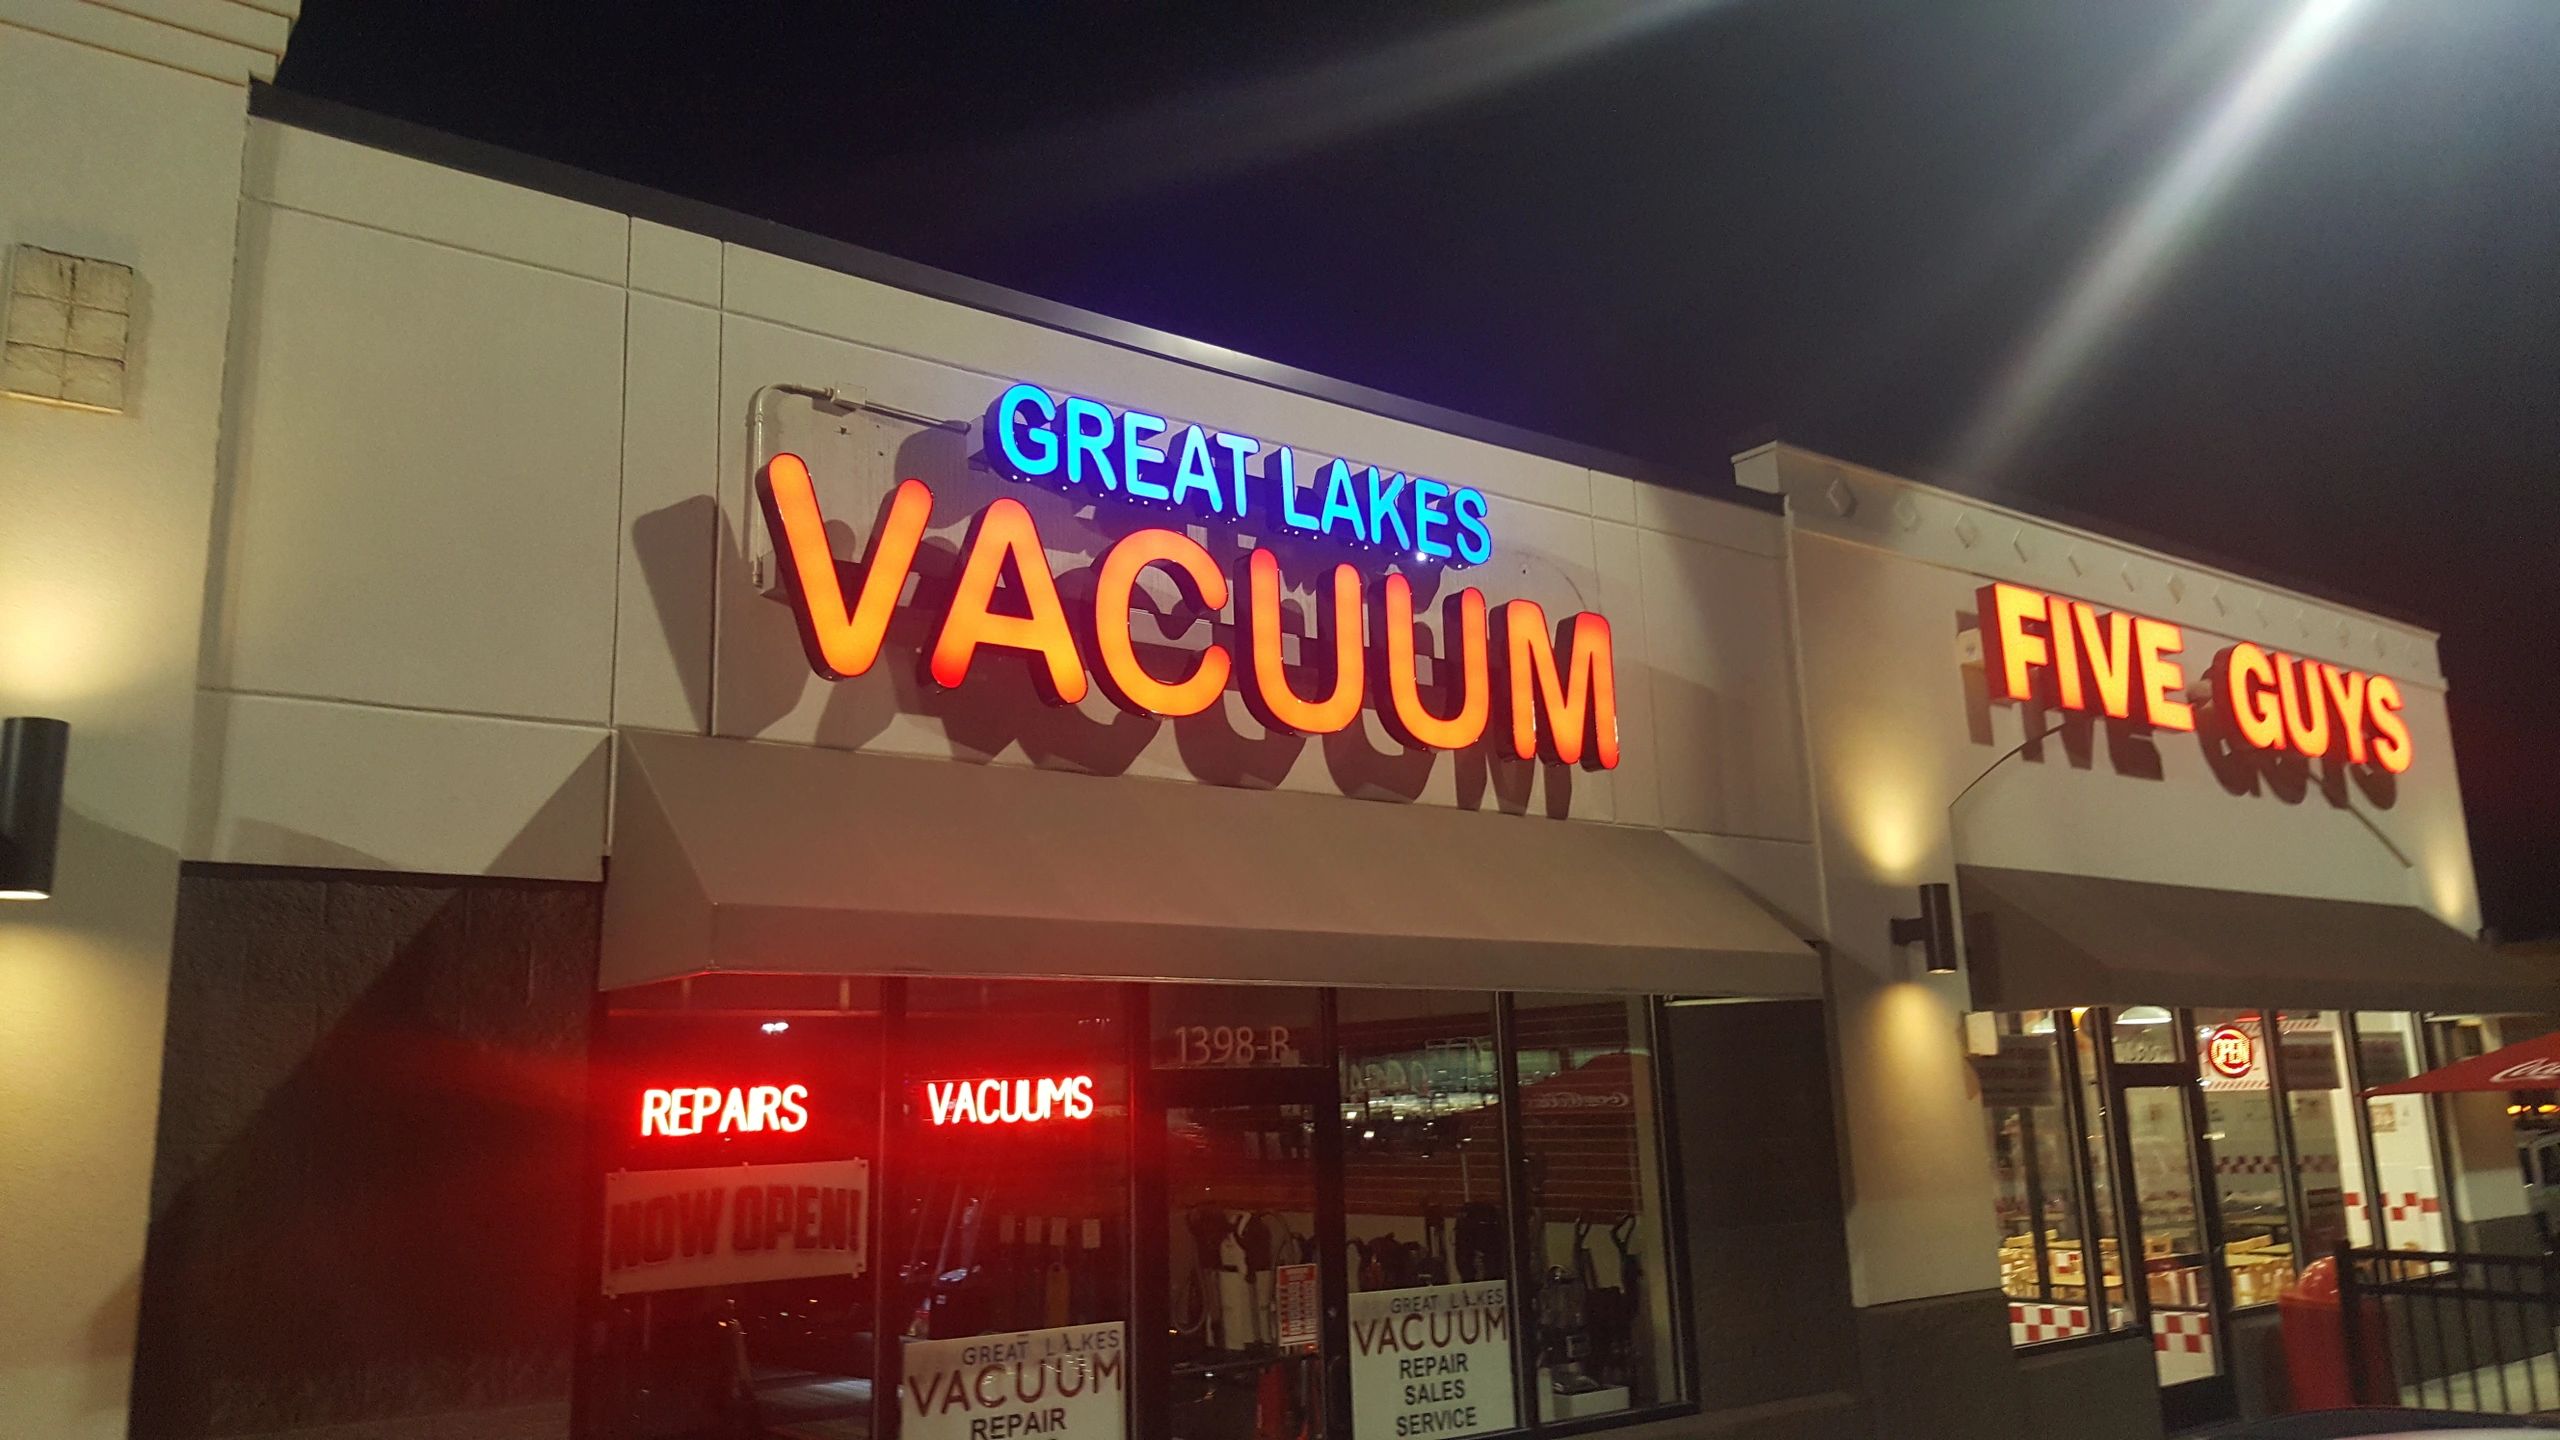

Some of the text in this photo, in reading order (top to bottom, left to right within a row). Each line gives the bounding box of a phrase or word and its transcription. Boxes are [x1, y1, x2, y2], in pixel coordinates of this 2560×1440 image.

[995, 382, 1493, 565] GREAT LAKES
[762, 452, 1620, 771] VACUUM
[1988, 582, 2414, 774] FIVE GUYS
[641, 1084, 809, 1137] REPAIRS
[927, 1076, 1094, 1126] VACUUMS
[608, 1184, 862, 1271] NOW OPEN!
[1391, 1294, 1438, 1314] GREAT
[962, 1338, 1029, 1366] GREAT
[1353, 1306, 1507, 1357] VACUUM
[909, 1350, 1122, 1418] VACUUM
[1400, 1353, 1469, 1380] REPAIR
[1405, 1378, 1466, 1406] SALES
[971, 1407, 1068, 1440] REPAIR
[1396, 1406, 1478, 1437] SERVICE
